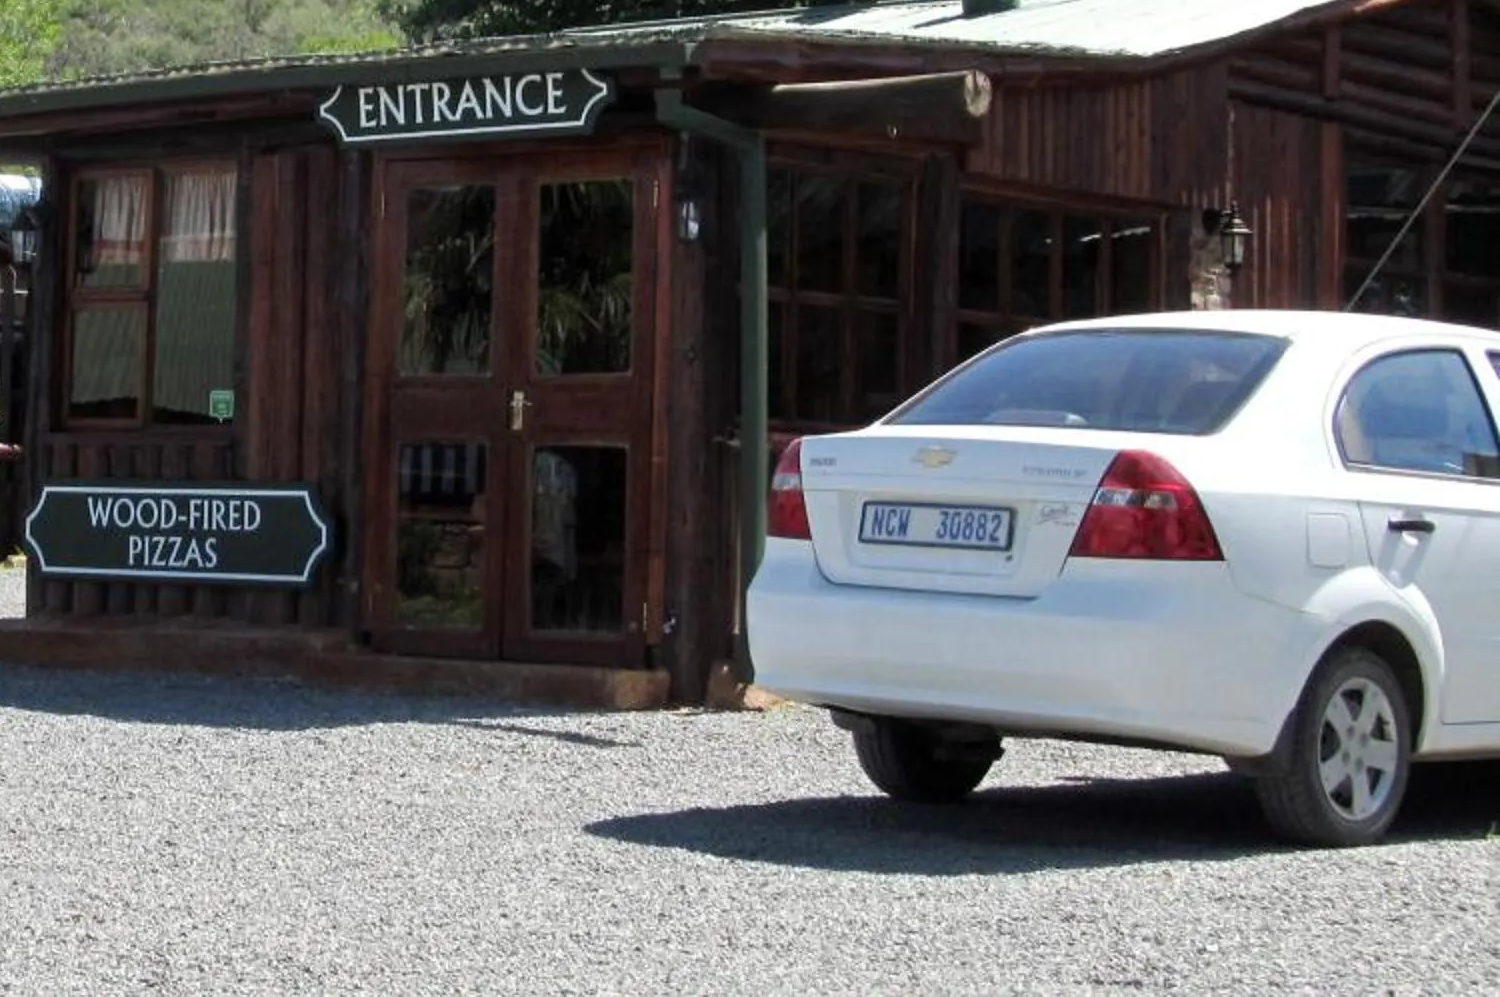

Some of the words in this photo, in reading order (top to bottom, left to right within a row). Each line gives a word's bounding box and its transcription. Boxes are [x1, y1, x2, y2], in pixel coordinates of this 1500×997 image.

[358, 72, 566, 128] ENTRANCE
[87, 497, 261, 531] WOOD-FIRED
[871, 506, 911, 537] NCW
[936, 510, 1002, 543] 30882
[128, 536, 218, 568] PIZZAS
